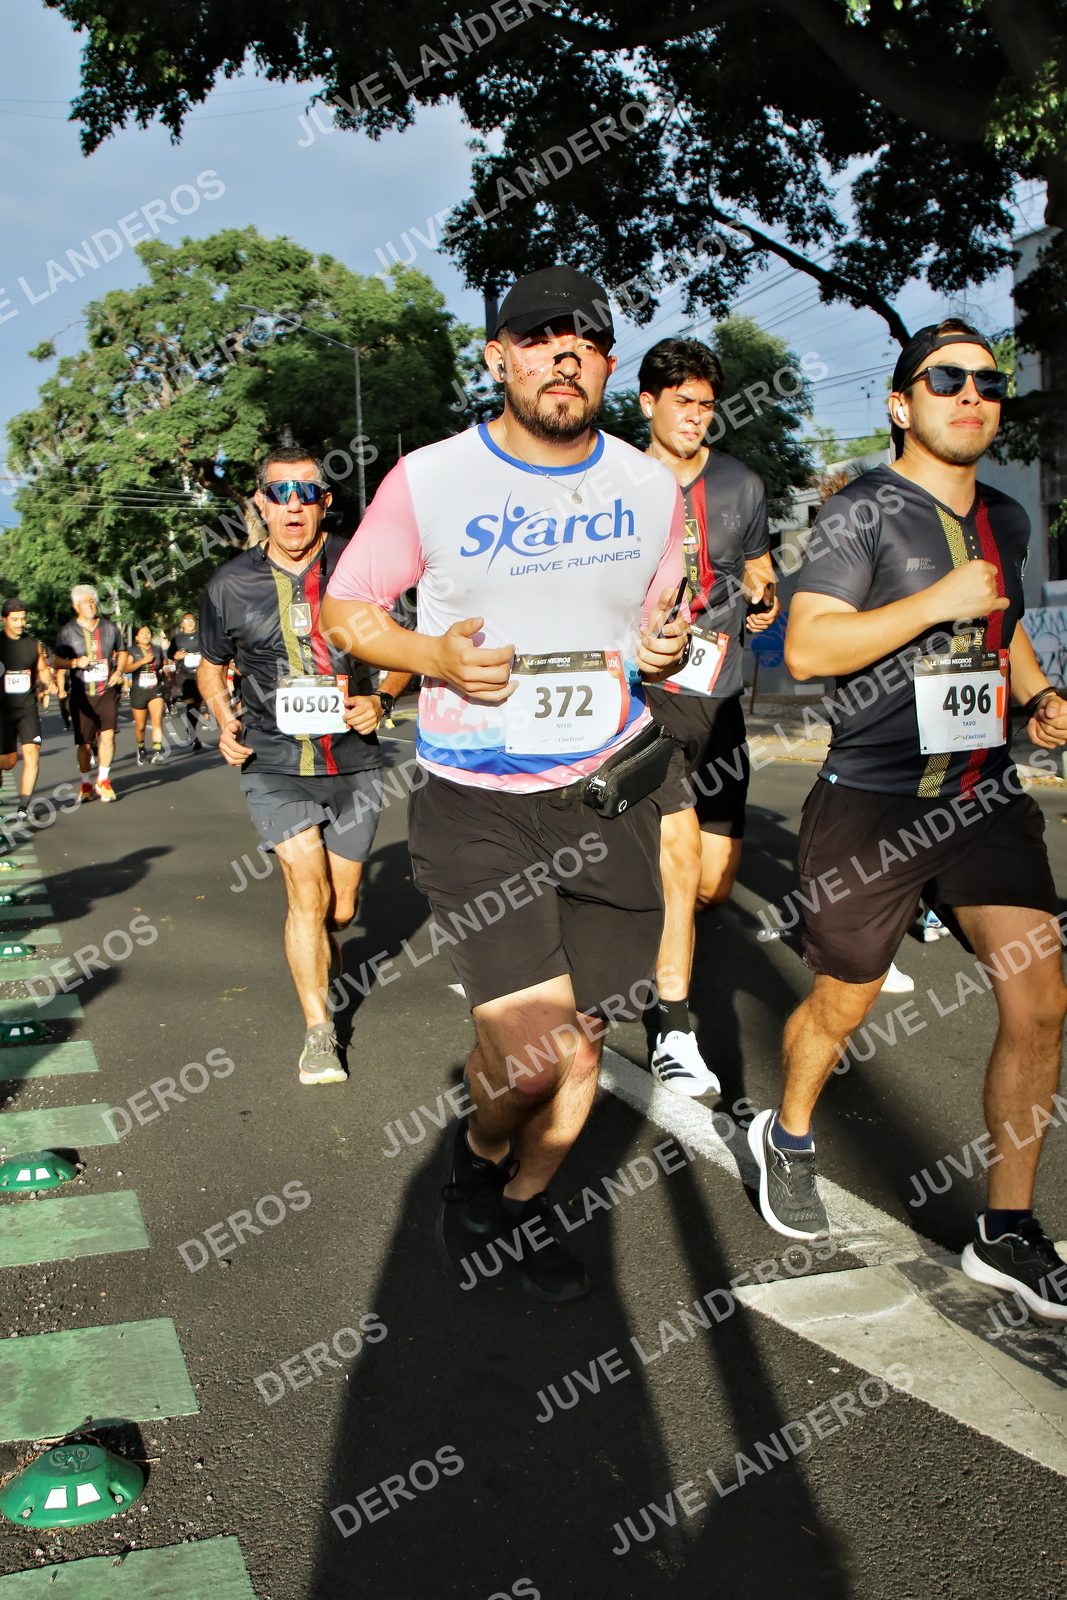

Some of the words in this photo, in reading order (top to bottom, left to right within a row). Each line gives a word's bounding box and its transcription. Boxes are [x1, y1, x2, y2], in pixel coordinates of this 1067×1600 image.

[510, 560, 563, 576] WAVE
[567, 549, 641, 568] RUNNERS
[281, 695, 340, 713] 10502
[534, 685, 593, 719] 372
[942, 683, 991, 716] 496
